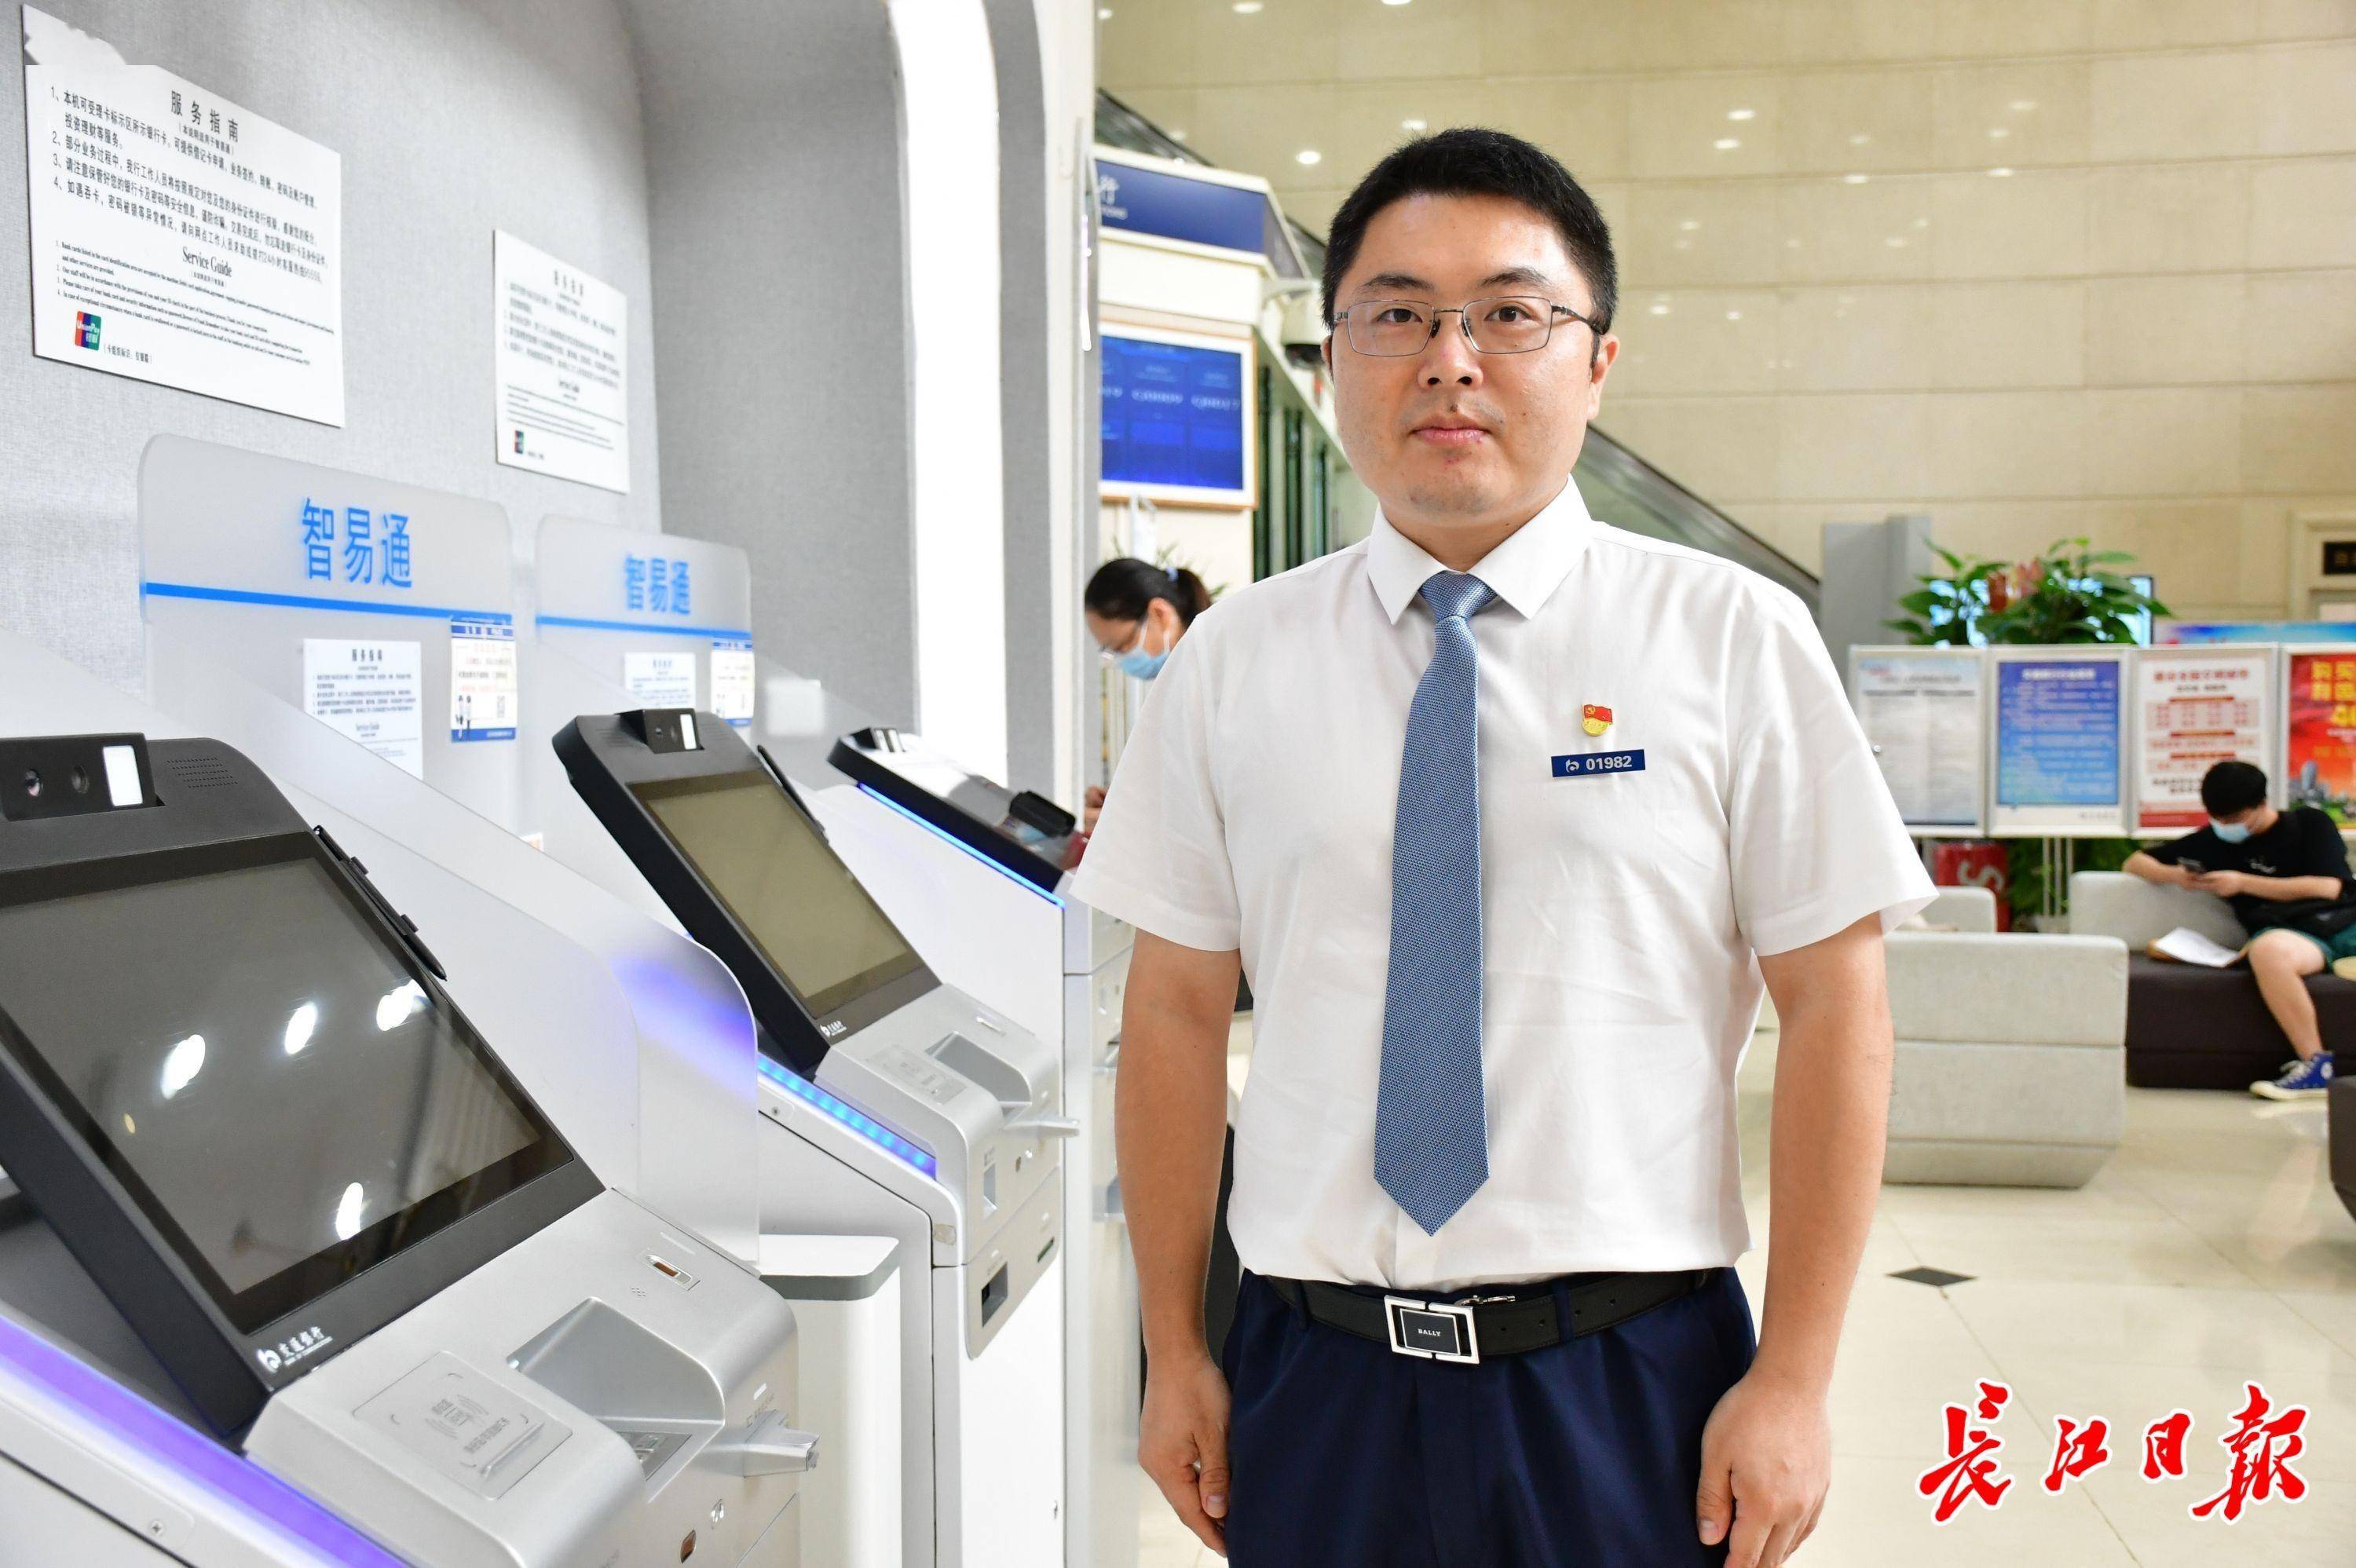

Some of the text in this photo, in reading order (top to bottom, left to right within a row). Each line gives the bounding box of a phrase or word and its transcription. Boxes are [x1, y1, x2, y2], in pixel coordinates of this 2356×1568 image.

[170, 90, 239, 144] 服务指南
[182, 246, 232, 277] Service Guide
[302, 497, 412, 588] 智易通
[625, 554, 691, 615] 智易通
[1586, 755, 1633, 770] 01982
[1418, 1328, 1441, 1337] BALLY
